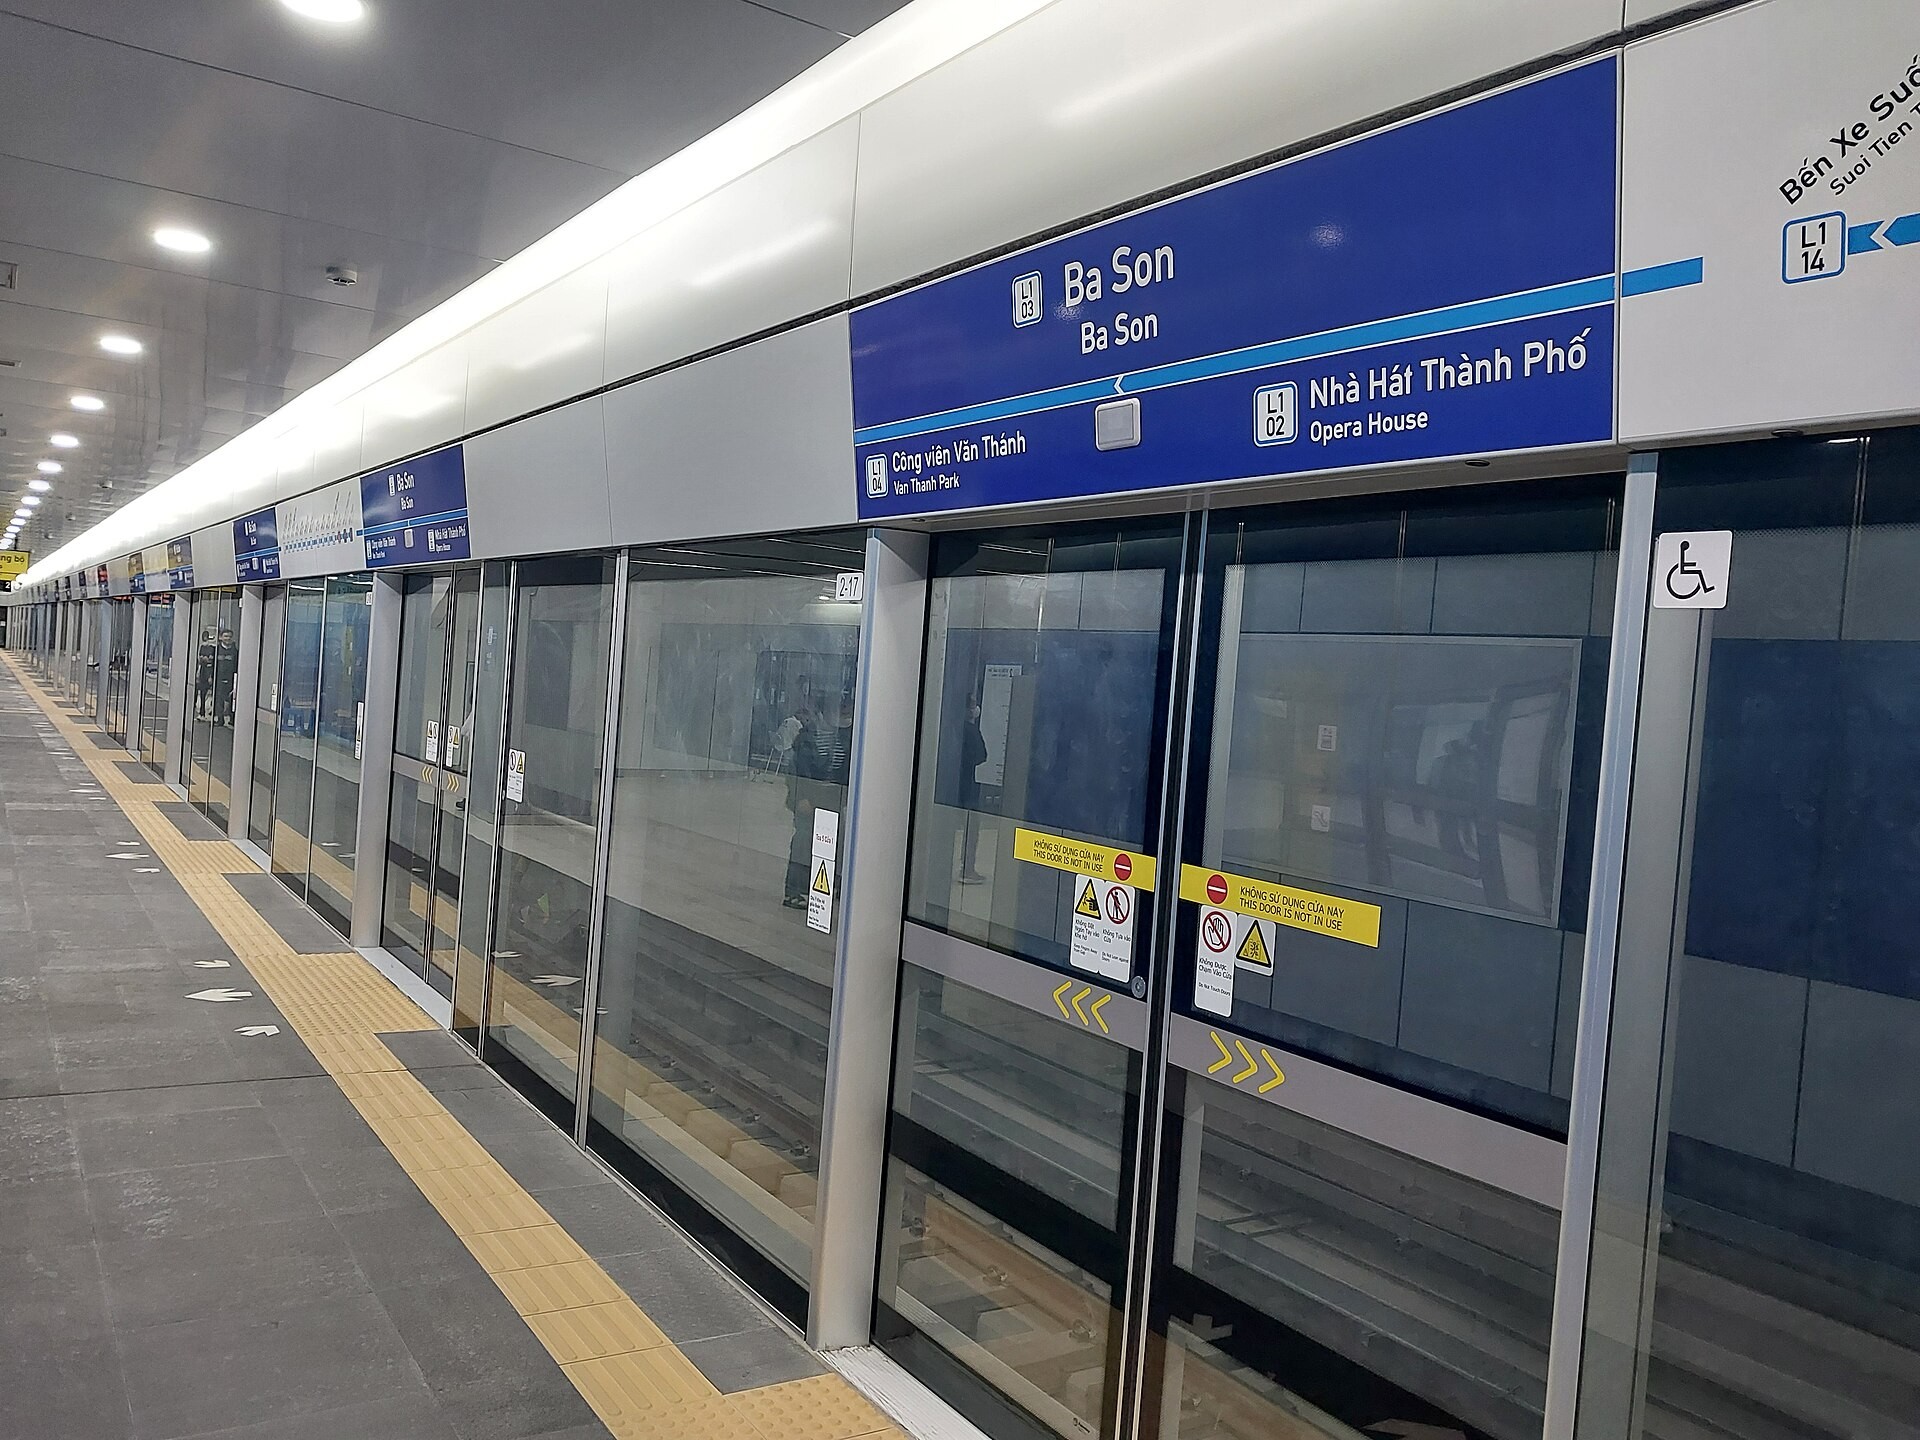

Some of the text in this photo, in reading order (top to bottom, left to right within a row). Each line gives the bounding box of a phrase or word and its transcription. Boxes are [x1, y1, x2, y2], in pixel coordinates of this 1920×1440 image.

[1779, 54, 1920, 205] Bến Xe Suố
[1830, 121, 1913, 196] Suoi Tien
[1801, 222, 1826, 248] L1
[1802, 248, 1824, 274] 14
[1065, 244, 1174, 308] Ba Son
[1021, 280, 1033, 300] L1
[1021, 300, 1034, 318] 03
[1081, 312, 1158, 354] Ba Son
[1310, 327, 1592, 408] Nhà Hát Thành Phố
[1266, 392, 1285, 414] L1
[1266, 416, 1286, 438] 02
[1310, 410, 1428, 446] Opera House
[892, 430, 1026, 474] Công viên Văn Thánh
[872, 461, 882, 476] L1
[872, 476, 882, 492] 04
[894, 472, 960, 495] Van Thanh Park
[840, 577, 858, 596] 2-17
[1034, 849, 1103, 872] THIS DOOR IS NOT IN USE
[1240, 886, 1267, 901] KHÔNG
[1269, 892, 1281, 903] SỬ
[1308, 900, 1324, 914] CỬA
[1240, 898, 1342, 930] THIS DOOR IS NOT IN USE
